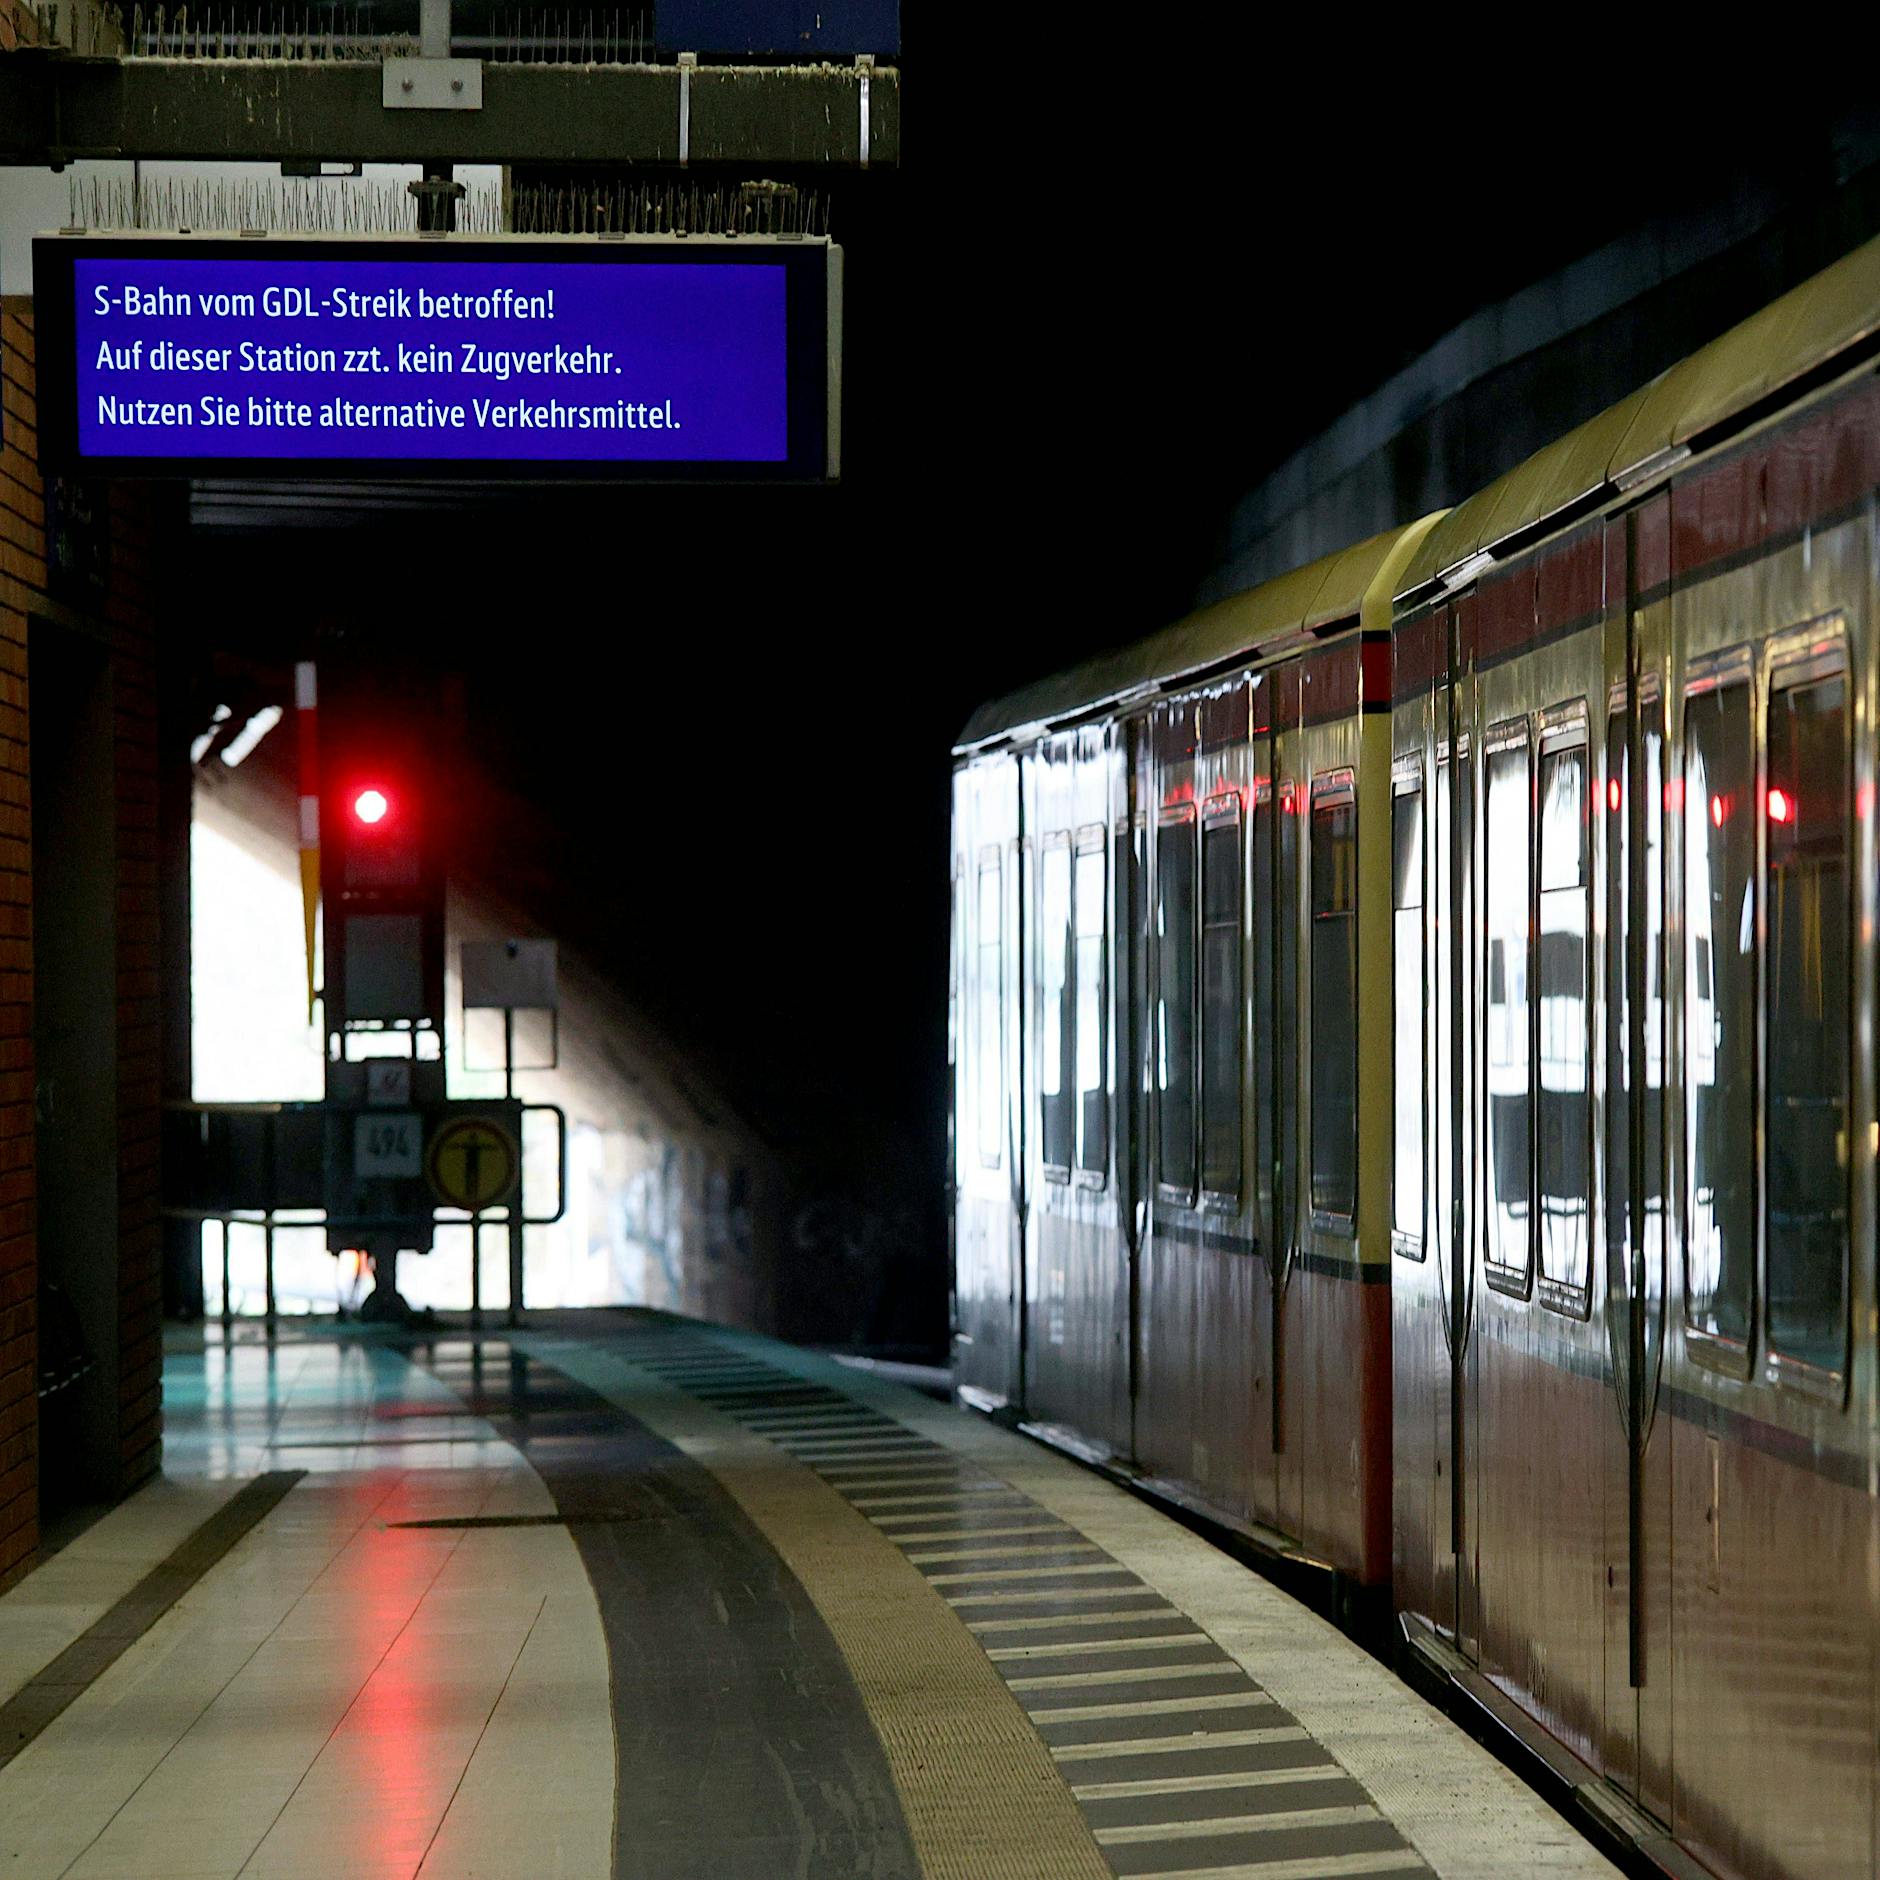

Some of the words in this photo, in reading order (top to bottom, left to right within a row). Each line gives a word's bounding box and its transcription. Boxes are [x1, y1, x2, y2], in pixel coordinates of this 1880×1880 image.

[94, 285, 192, 317] S-Bahn
[198, 294, 255, 318] vom
[262, 286, 412, 319] GDL-Streik
[418, 287, 556, 320] betroffen!
[95, 340, 143, 372] Auf
[149, 340, 233, 373] dieser
[239, 341, 336, 373] Station
[342, 346, 390, 374] zzt.
[398, 342, 453, 374] kein
[460, 343, 623, 382] Zugverkehr.
[98, 395, 193, 427] Nutzen
[200, 395, 241, 427] Sie
[248, 396, 312, 428] bitte
[319, 396, 466, 429] alternative
[472, 398, 682, 430] Verkehrsmittel.
